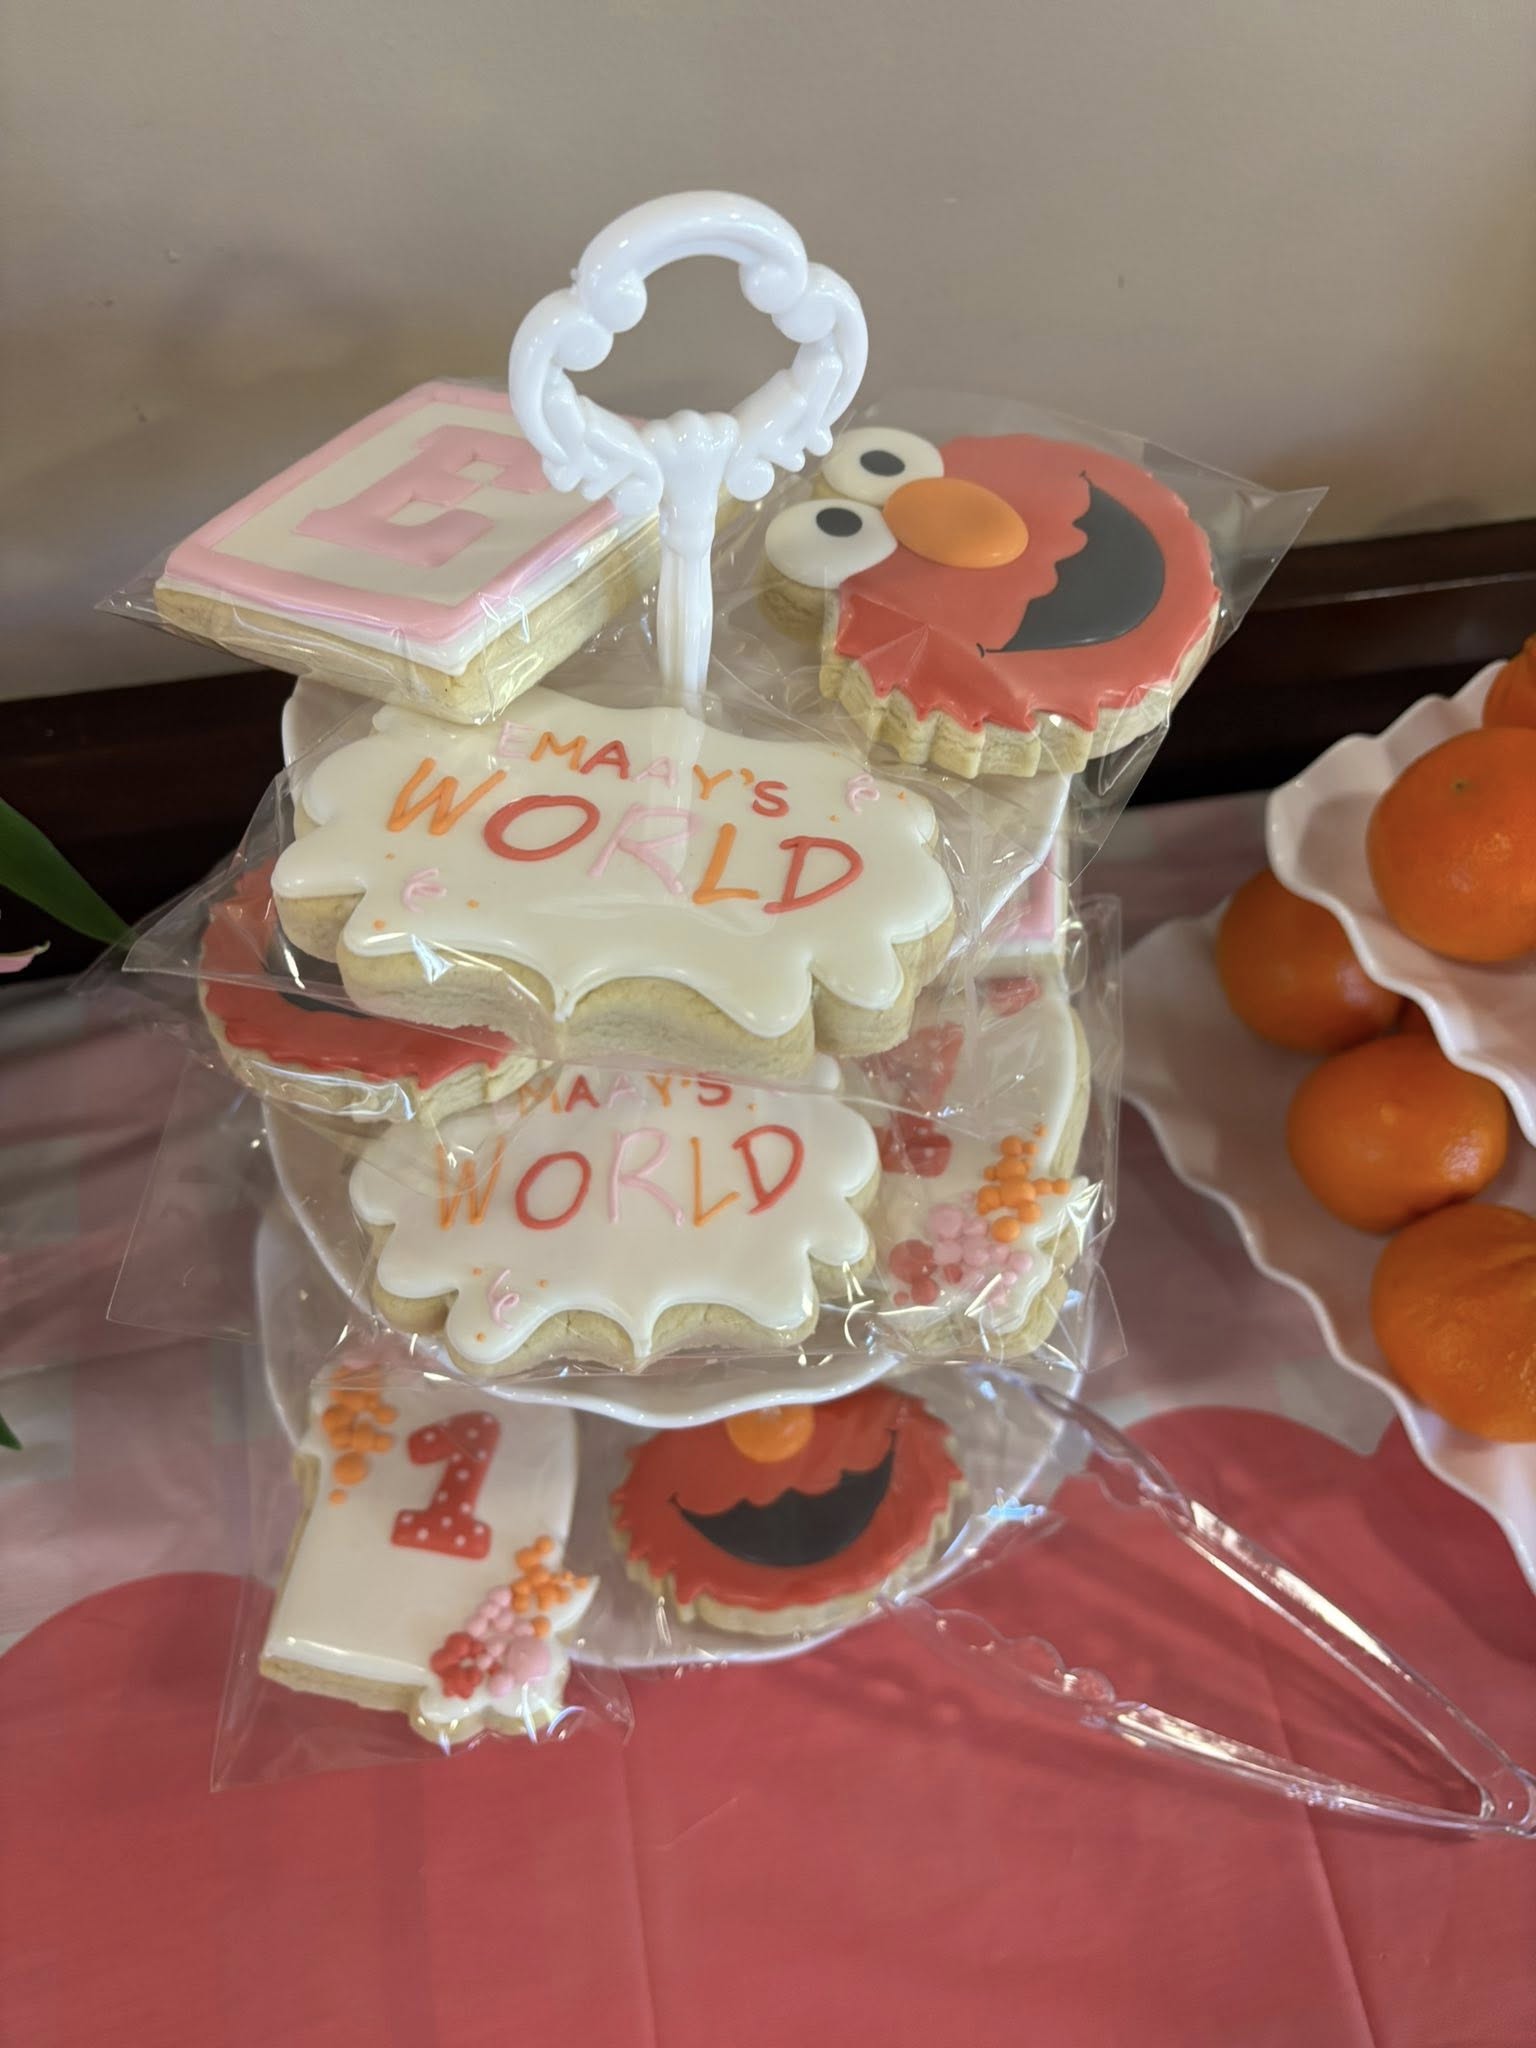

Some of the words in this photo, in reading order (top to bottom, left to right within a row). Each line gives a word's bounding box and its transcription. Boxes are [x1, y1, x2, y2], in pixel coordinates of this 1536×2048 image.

[292, 424, 549, 568] E
[499, 720, 789, 818] EMAAY'S
[386, 757, 864, 914] WORLD
[492, 1070, 733, 1126] MAAY'S
[437, 1124, 804, 1231] WORLD
[391, 1411, 502, 1562] 1
